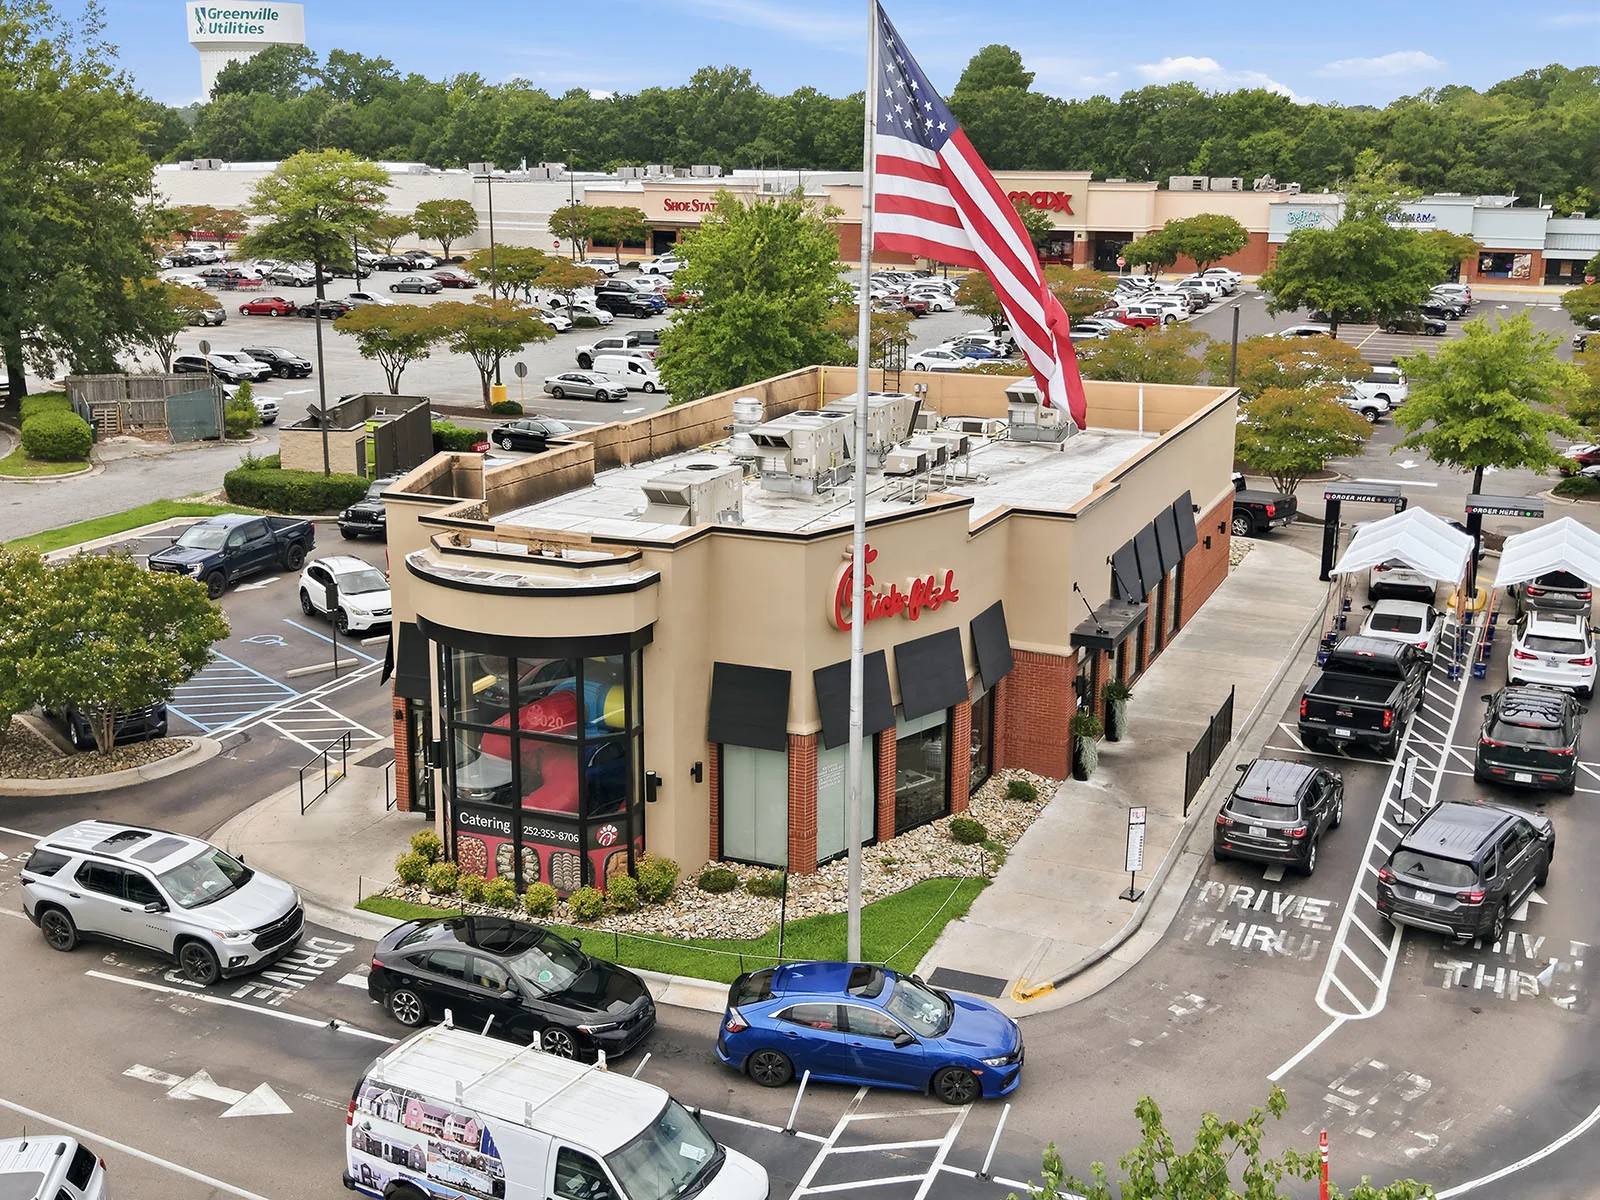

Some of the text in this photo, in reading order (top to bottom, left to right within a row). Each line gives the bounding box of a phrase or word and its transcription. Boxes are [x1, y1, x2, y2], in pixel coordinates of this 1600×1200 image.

[207, 7, 279, 20] Greenville
[208, 22, 265, 34] Utilities
[1472, 507, 1498, 515] ORDER
[459, 812, 511, 834] Catering
[523, 825, 579, 843] 252-355-8706
[1196, 880, 1333, 923] DRIVE
[230, 936, 355, 1006] DRIVE
